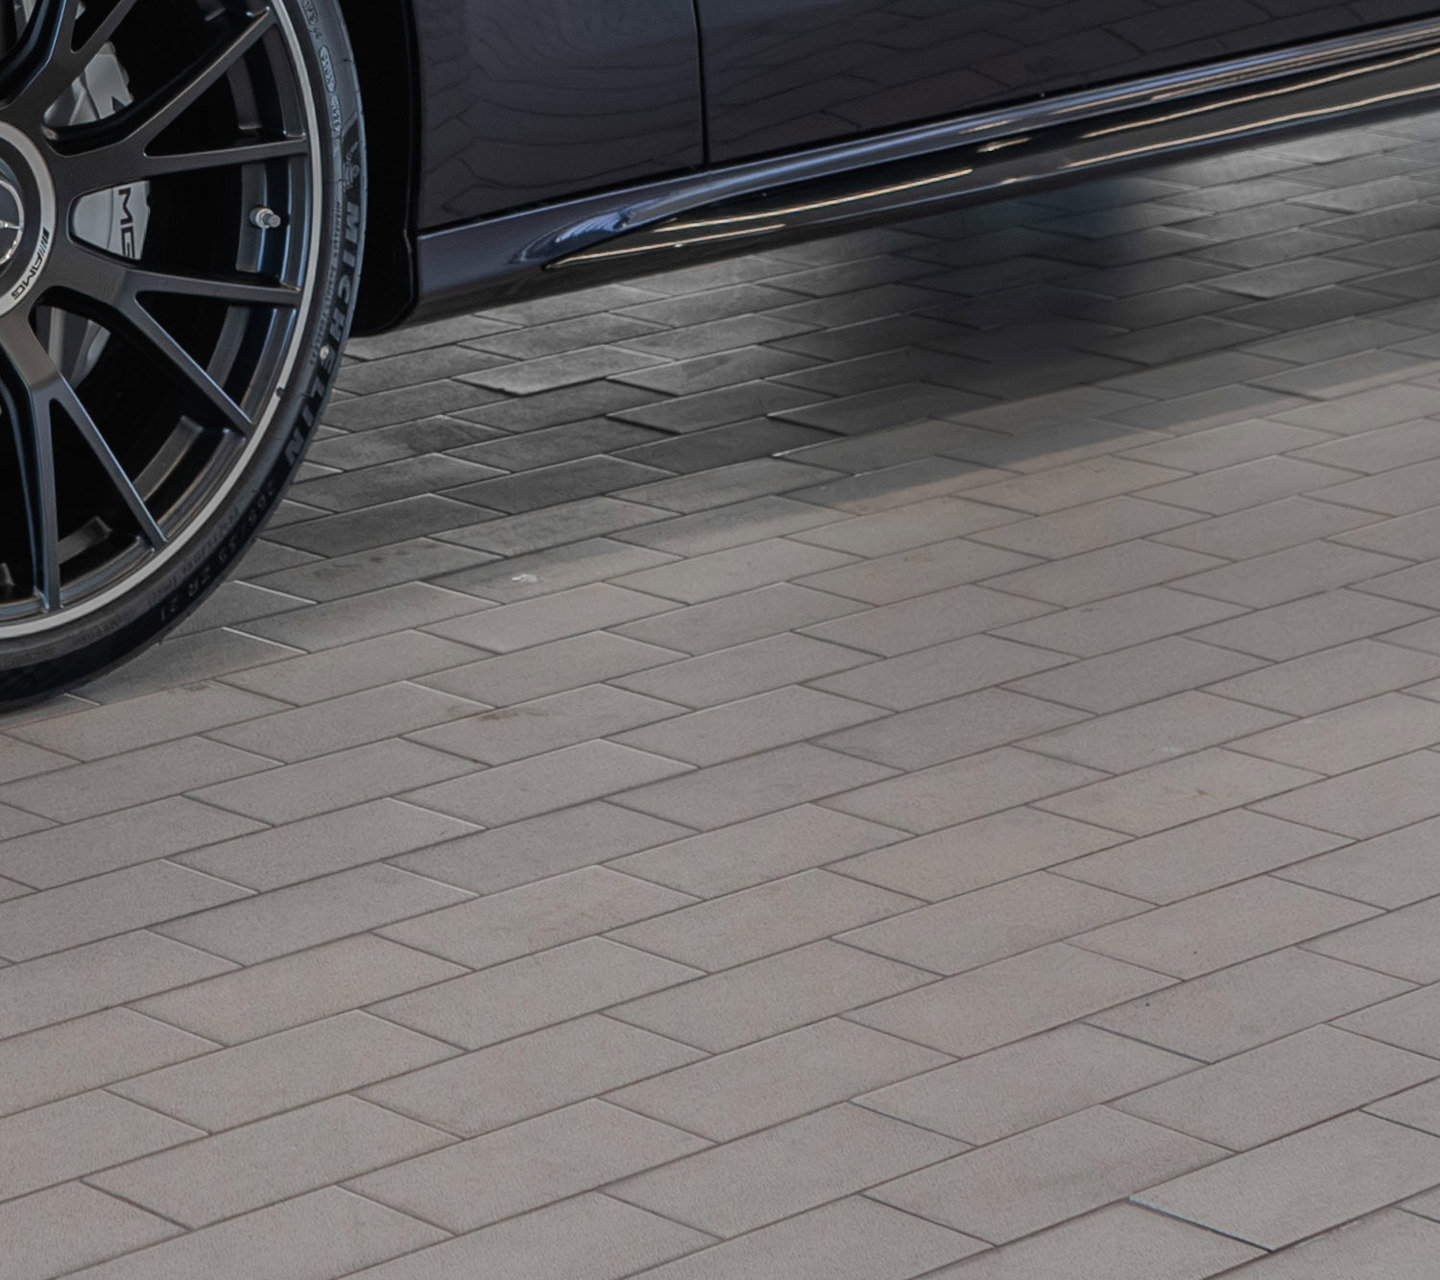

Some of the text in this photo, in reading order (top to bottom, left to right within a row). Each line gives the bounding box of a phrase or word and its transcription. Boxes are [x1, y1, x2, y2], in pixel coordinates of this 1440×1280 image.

[118, 187, 135, 258] MG
[11, 254, 43, 300] AMG
[285, 199, 359, 467] MICHELIN
